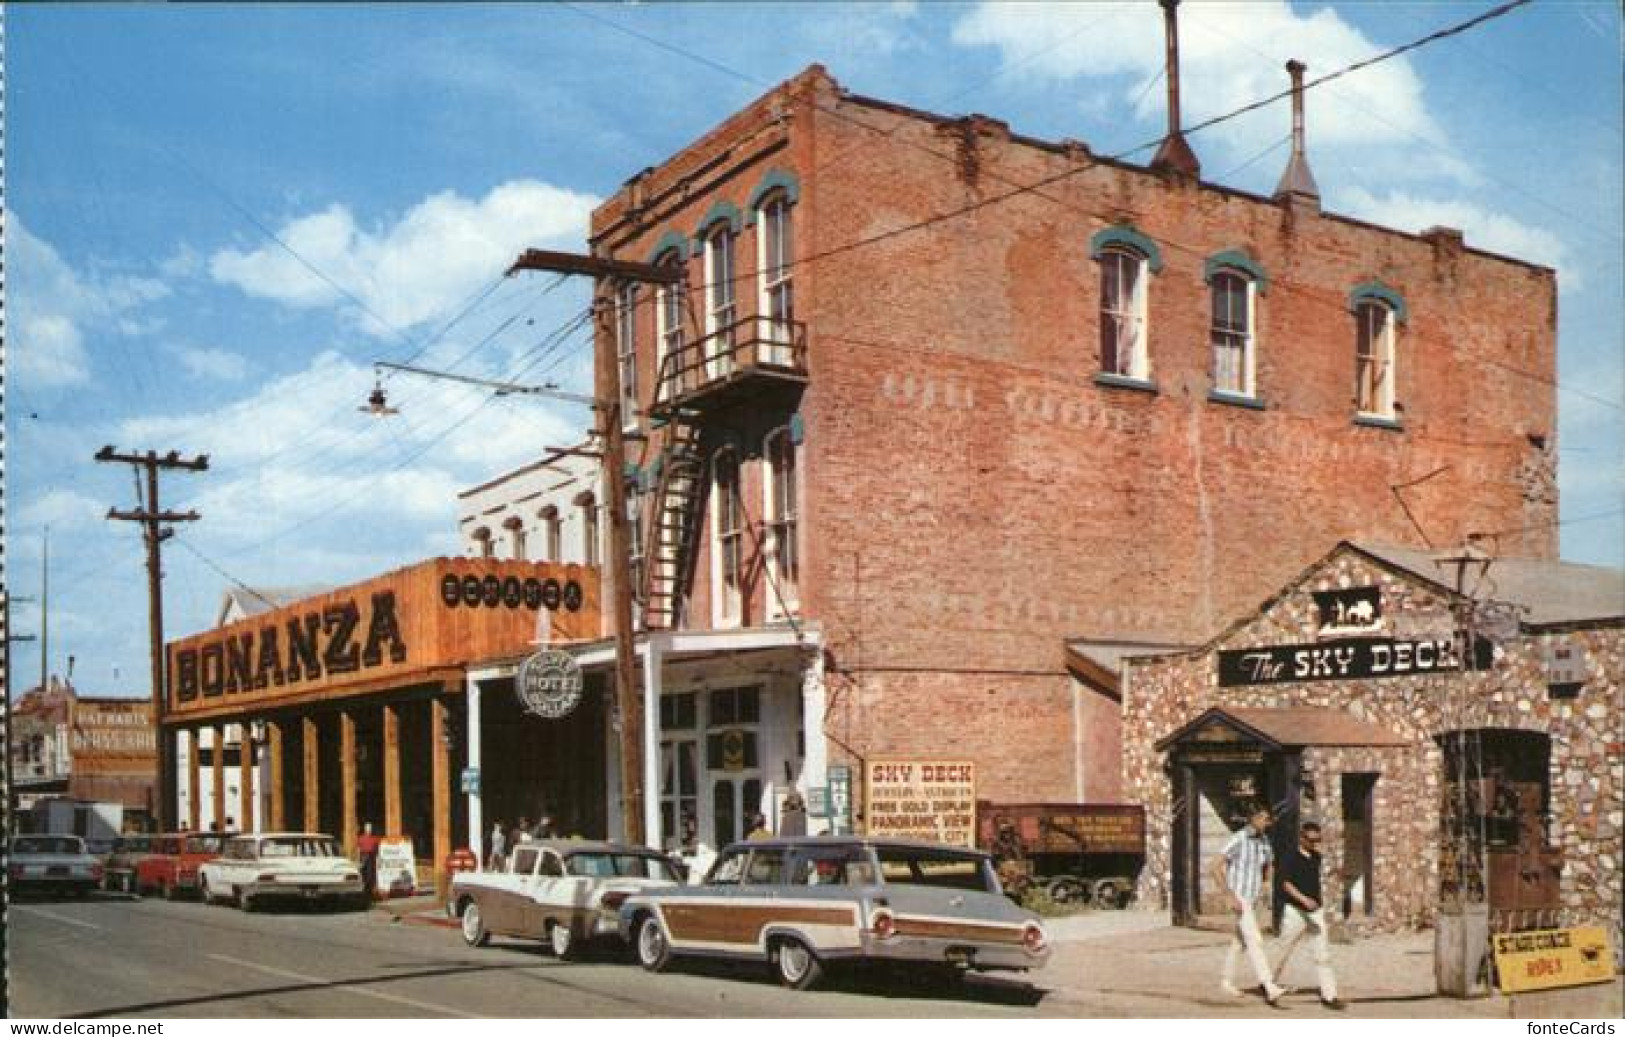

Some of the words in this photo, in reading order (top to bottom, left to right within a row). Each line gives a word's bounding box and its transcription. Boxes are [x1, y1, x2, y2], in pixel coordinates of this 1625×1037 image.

[442, 577, 581, 609] BONANZA
[176, 590, 406, 703] BONANZA
[1240, 651, 1284, 681] The
[1294, 648, 1355, 677] SKY
[1370, 640, 1459, 672] DECK
[872, 765, 912, 782] SKY
[922, 765, 971, 782] DECK
[872, 802, 896, 813] FREE
[901, 801, 929, 813] GOLD
[872, 815, 939, 829] PANORAMIC
[943, 815, 971, 827] VIEW
